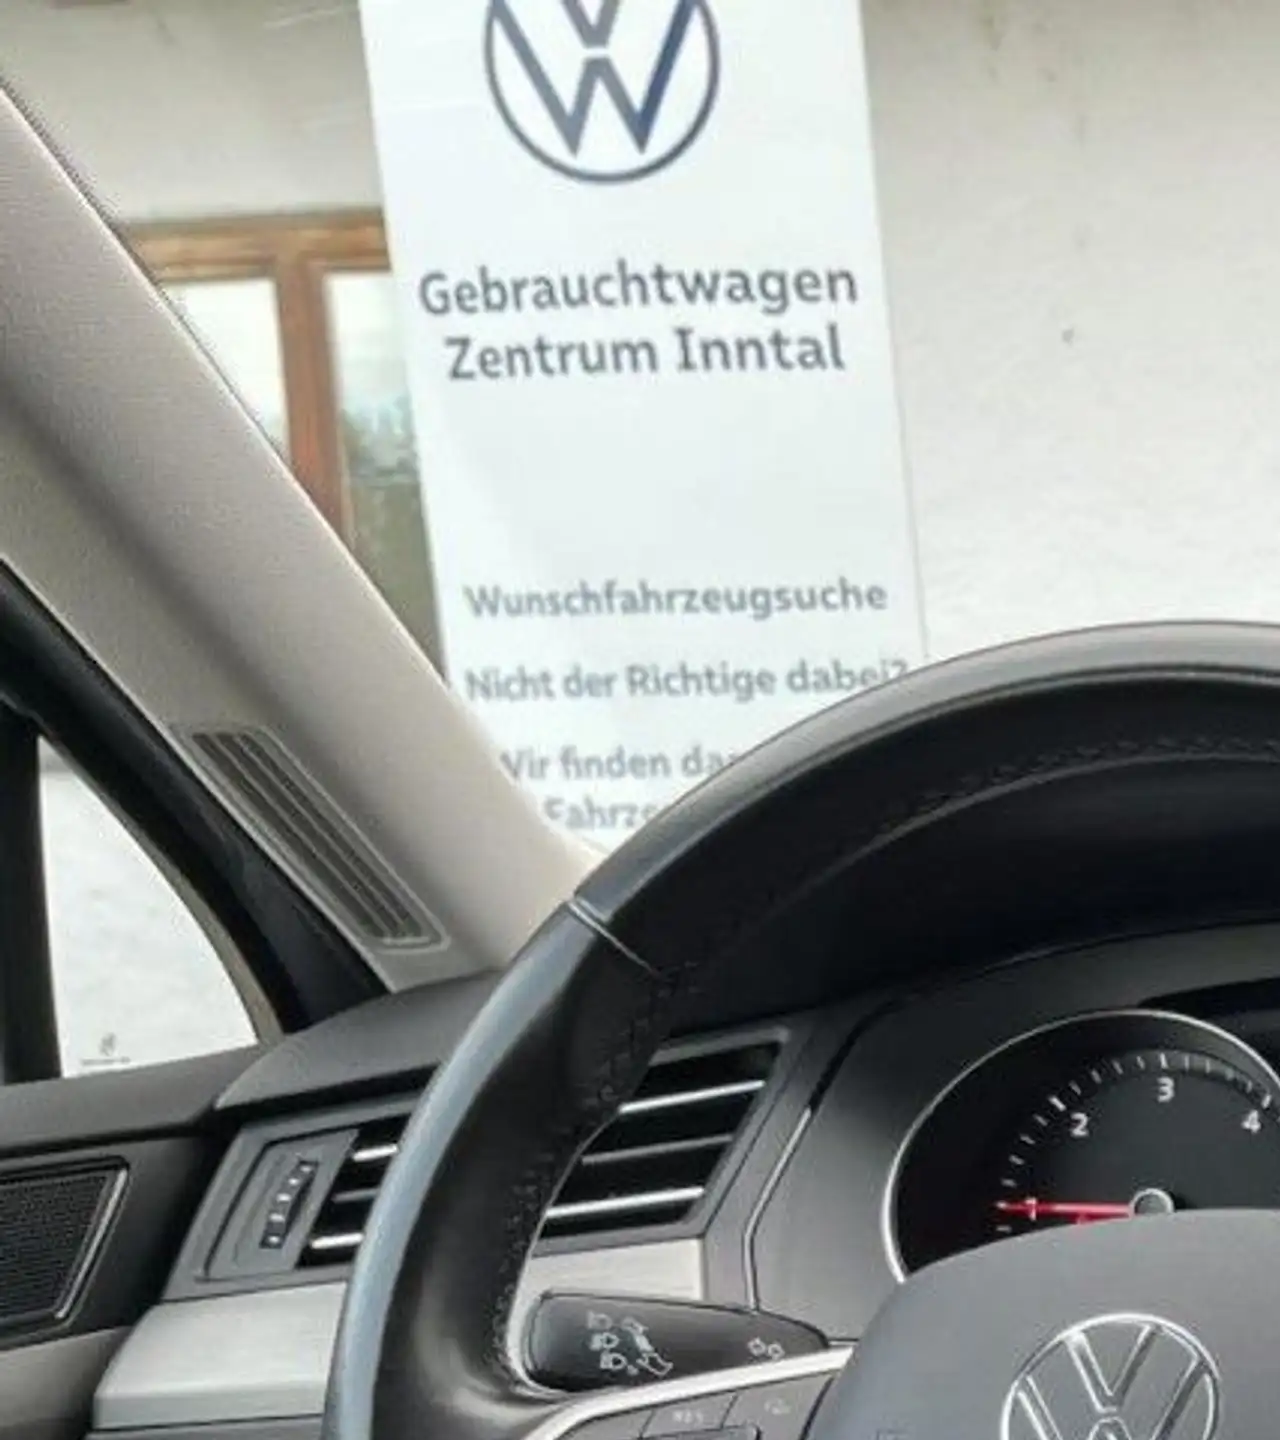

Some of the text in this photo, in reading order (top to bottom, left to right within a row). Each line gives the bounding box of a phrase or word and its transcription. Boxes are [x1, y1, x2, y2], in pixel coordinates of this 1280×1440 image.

[418, 259, 859, 315] Gebrauchtwagen
[444, 322, 847, 381] Zentrum Inntal
[463, 576, 889, 622] Wunschfahrzeugsuche
[465, 665, 556, 702] Nicht
[562, 664, 619, 700] der
[626, 660, 777, 704] Richtige
[560, 744, 672, 781] finden
[1157, 1077, 1176, 1103] 3
[1071, 1112, 1090, 1138] 2
[1241, 1109, 1262, 1135] 4
